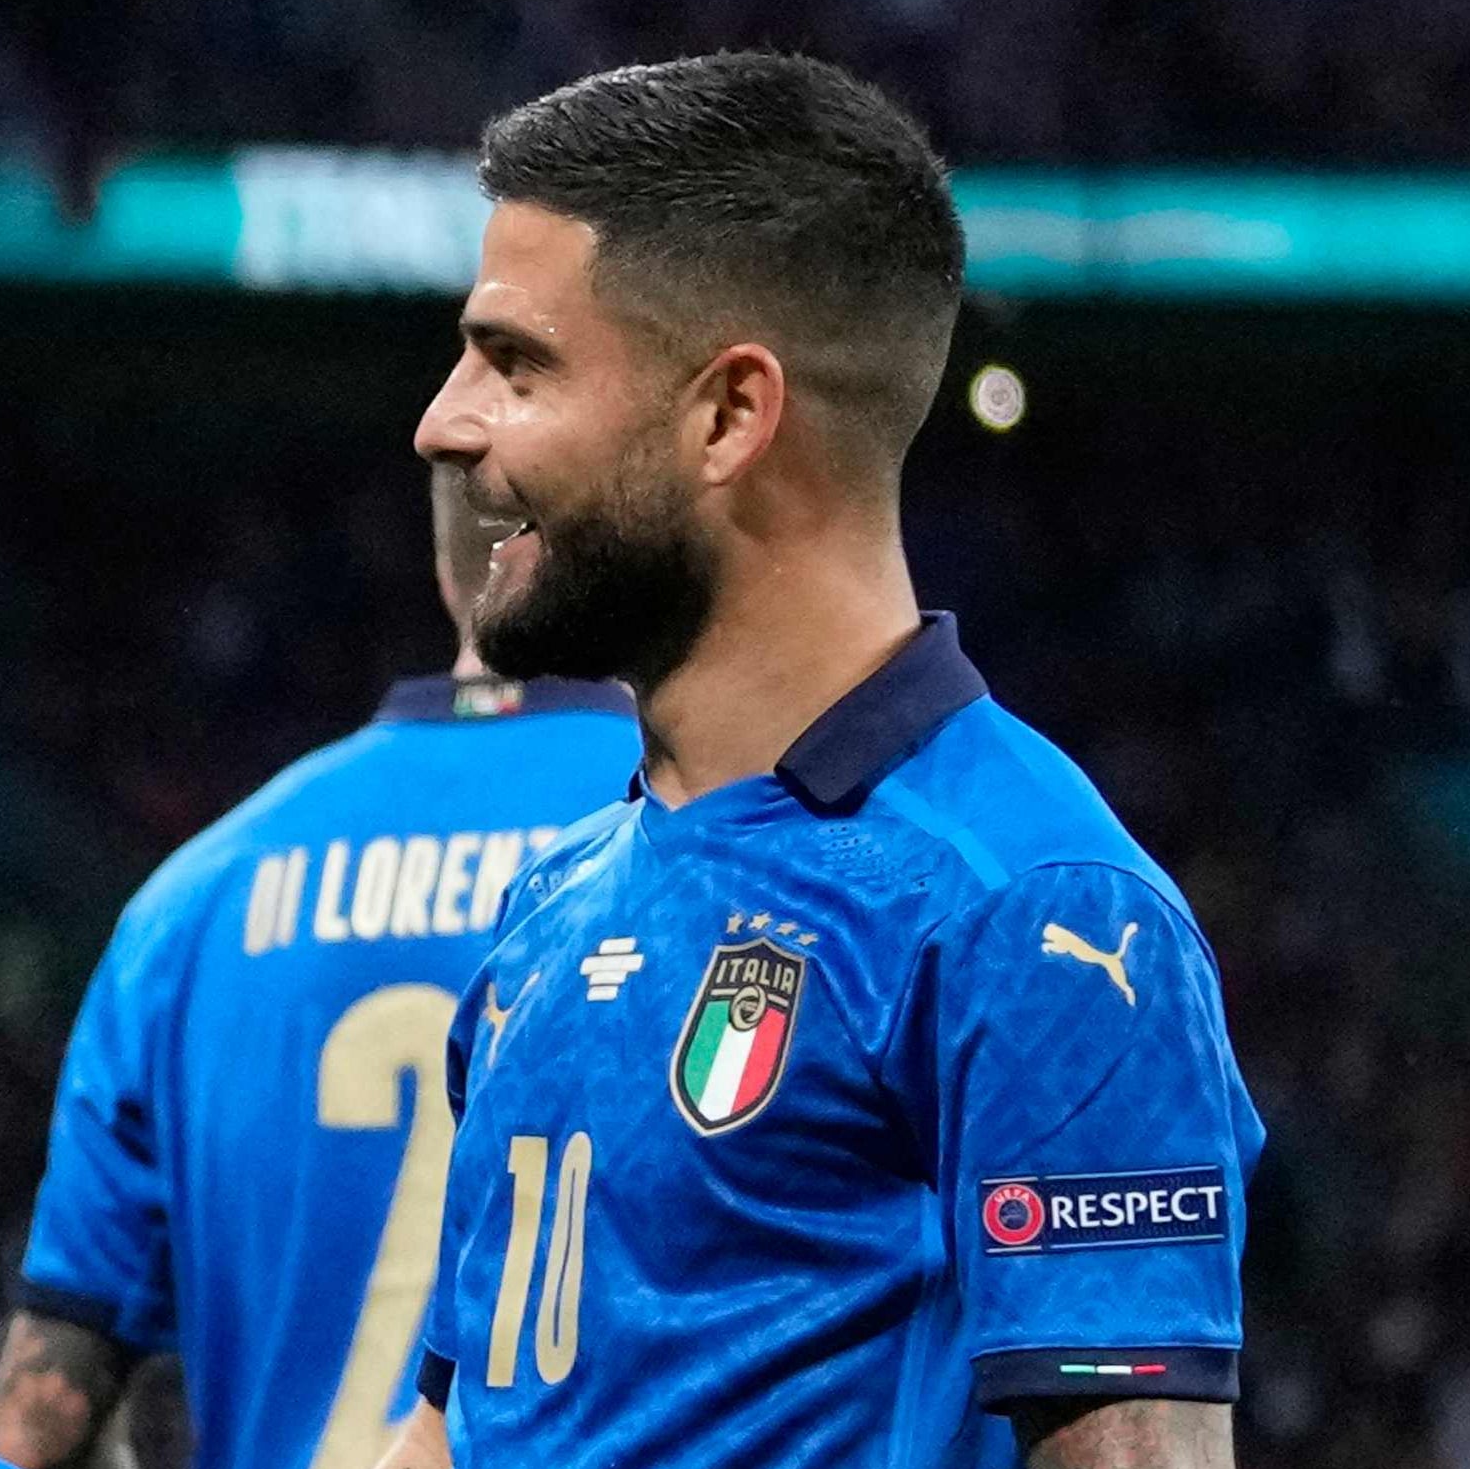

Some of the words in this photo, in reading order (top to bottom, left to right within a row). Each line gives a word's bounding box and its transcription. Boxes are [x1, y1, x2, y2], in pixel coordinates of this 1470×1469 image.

[313, 827, 559, 942] LOREN
[716, 958, 796, 994] ITALIA
[1051, 1186, 1223, 1229] RESPECT
[486, 1131, 592, 1388] 10
